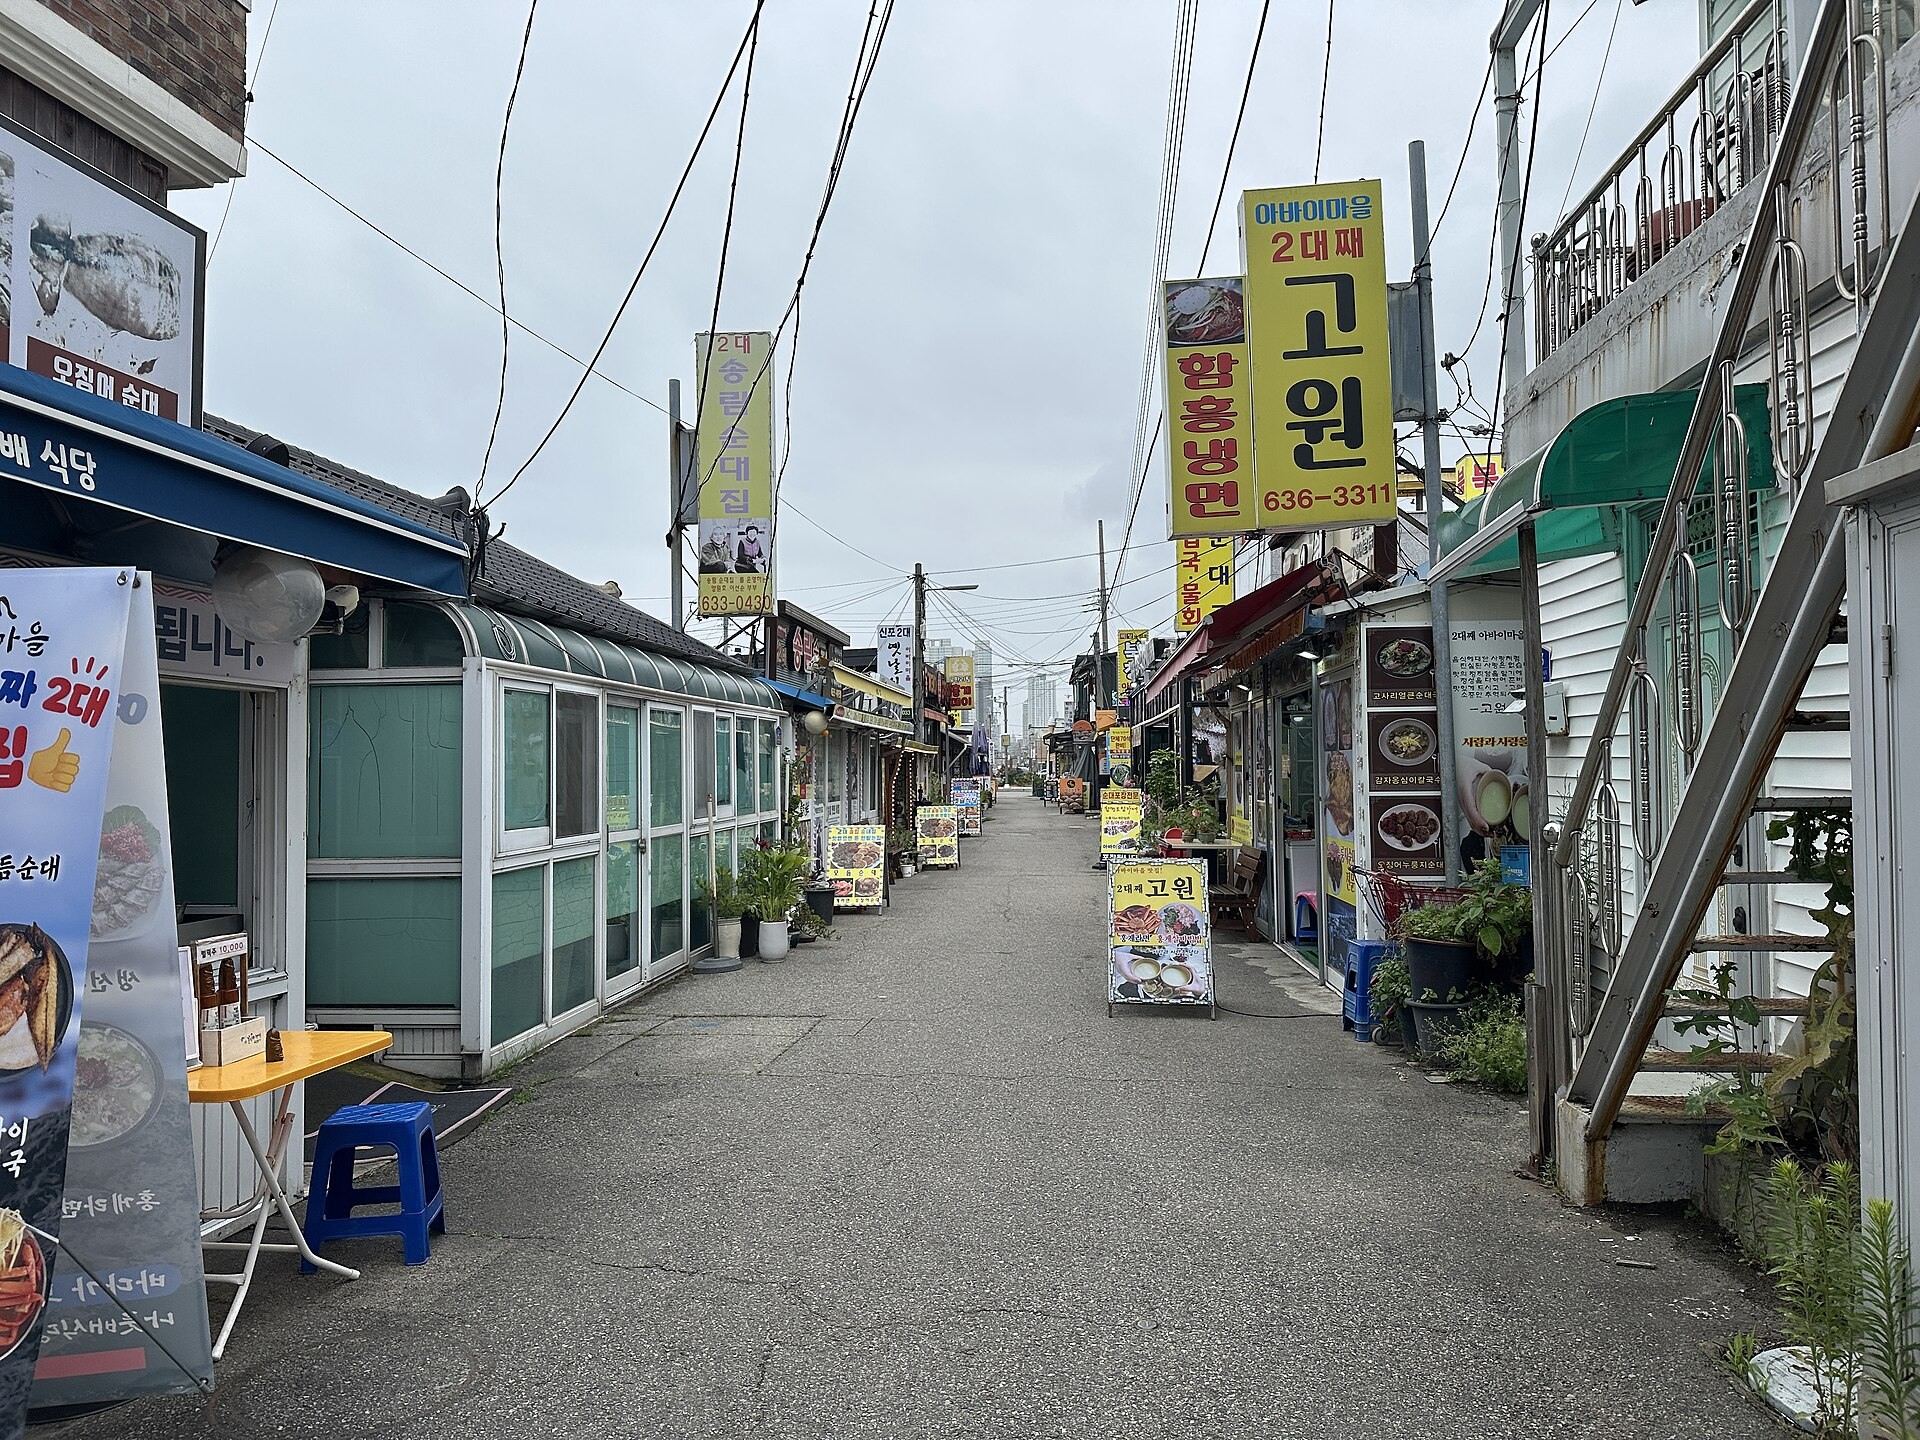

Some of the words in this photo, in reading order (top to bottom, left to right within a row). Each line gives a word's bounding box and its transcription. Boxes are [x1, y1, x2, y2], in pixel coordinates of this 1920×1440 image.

[1255, 195, 1372, 224] 아바이마을
[1271, 227, 1364, 262] 2대째
[53, 355, 115, 400] 오징어
[121, 382, 159, 416] 순대
[1283, 272, 1367, 470] 고원
[719, 358, 750, 514] 송림순대집
[1177, 352, 1240, 518] 함흥냉면
[40, 439, 97, 491] 식당
[1263, 482, 1390, 511] 636-3311
[702, 595, 771, 611] 633-0430
[879, 627, 911, 638] 신포2대
[1451, 630, 1476, 641] 2대째
[42, 676, 110, 728] 2대
[1103, 792, 1139, 800] 순대포장전문
[1117, 884, 1143, 894] 2대째
[1145, 877, 1195, 900] 고원
[219, 942, 243, 954] 10,000
